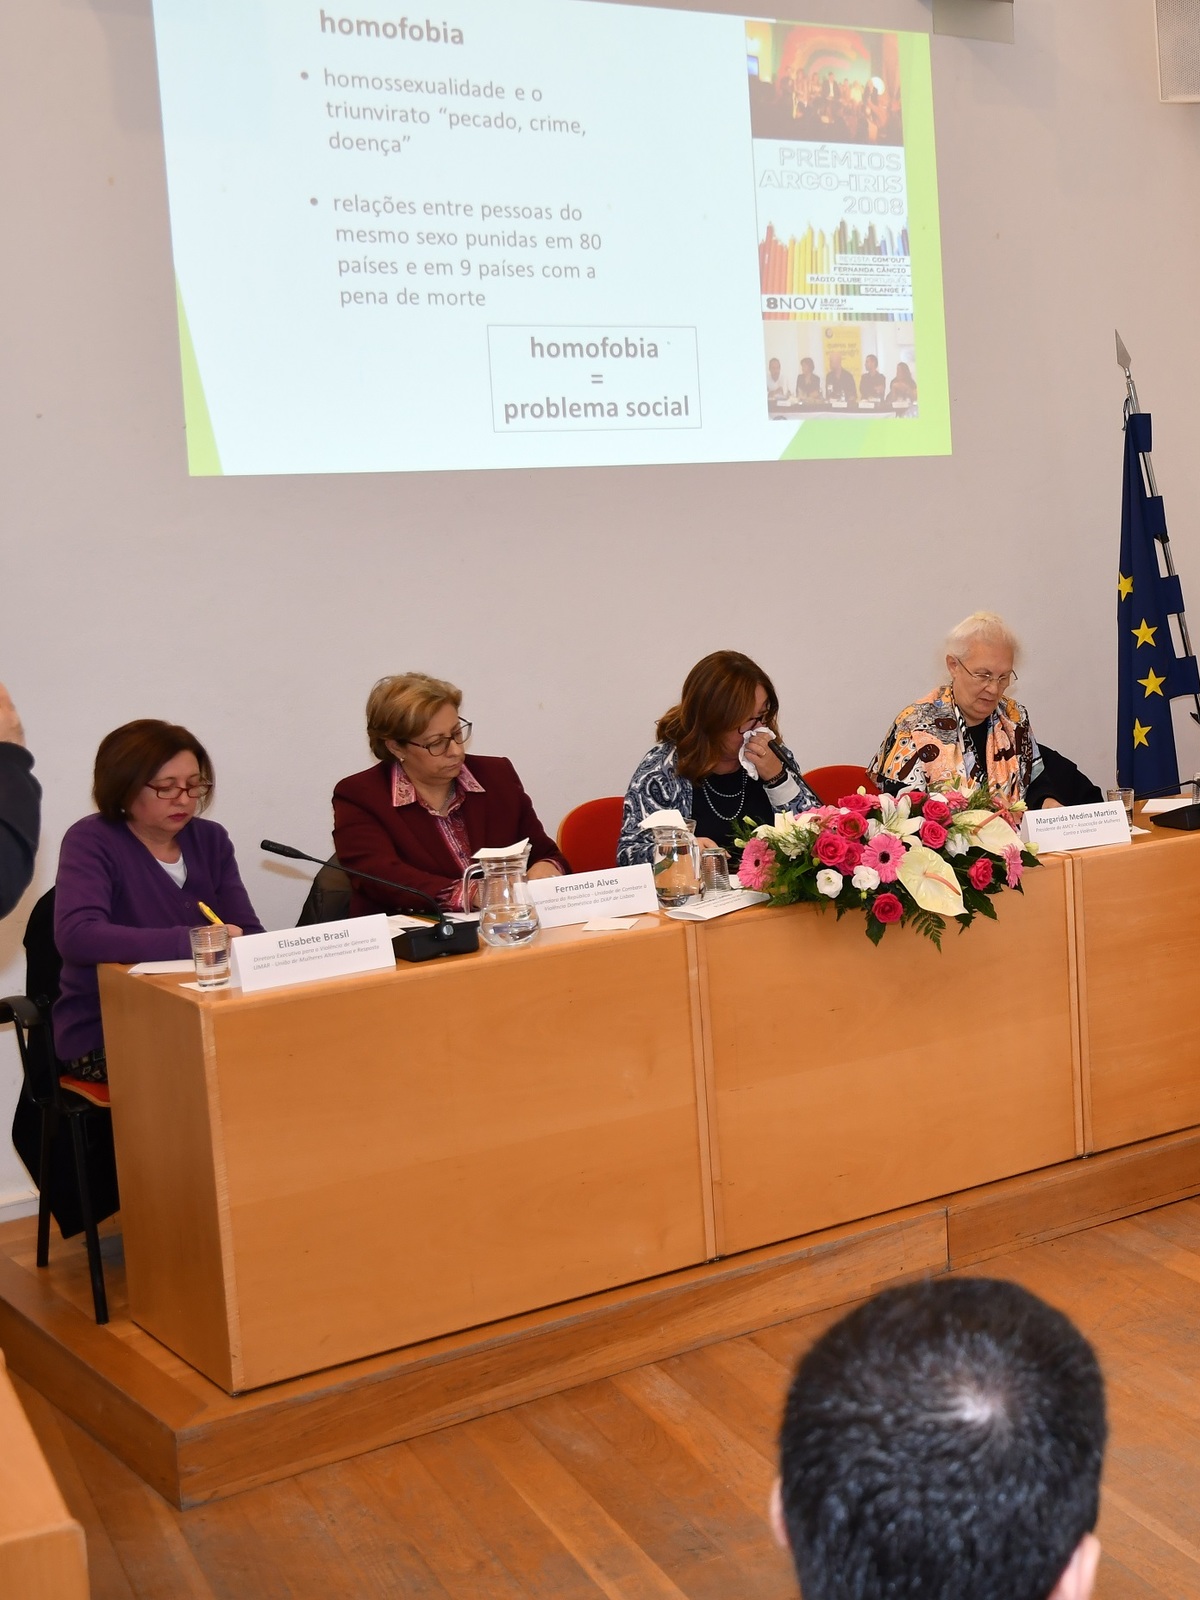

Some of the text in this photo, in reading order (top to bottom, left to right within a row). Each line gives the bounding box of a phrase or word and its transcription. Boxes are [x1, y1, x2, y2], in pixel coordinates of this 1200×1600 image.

[320, 9, 464, 46] homofobia
[323, 68, 543, 102] homossexualidade e o
[326, 101, 431, 125] triunvirato
[529, 115, 587, 137] crime,
[779, 145, 901, 171] PRÉMIOS
[333, 195, 583, 223] relações entre pessoas do
[843, 197, 904, 215] 2008
[335, 227, 602, 252] mesmo sexo punidas em 80
[338, 256, 596, 281] países e em 9 países com a
[340, 287, 486, 308] pena de morte
[530, 337, 659, 360] homofobia
[504, 396, 689, 423] problema social
[1036, 809, 1117, 824] Margarida Medina Martins
[555, 878, 618, 893] Fernanda Alves
[278, 929, 349, 949] Elisabete Brasil
[324, 949, 352, 958] Alternativa
[358, 944, 379, 953] Resposta
